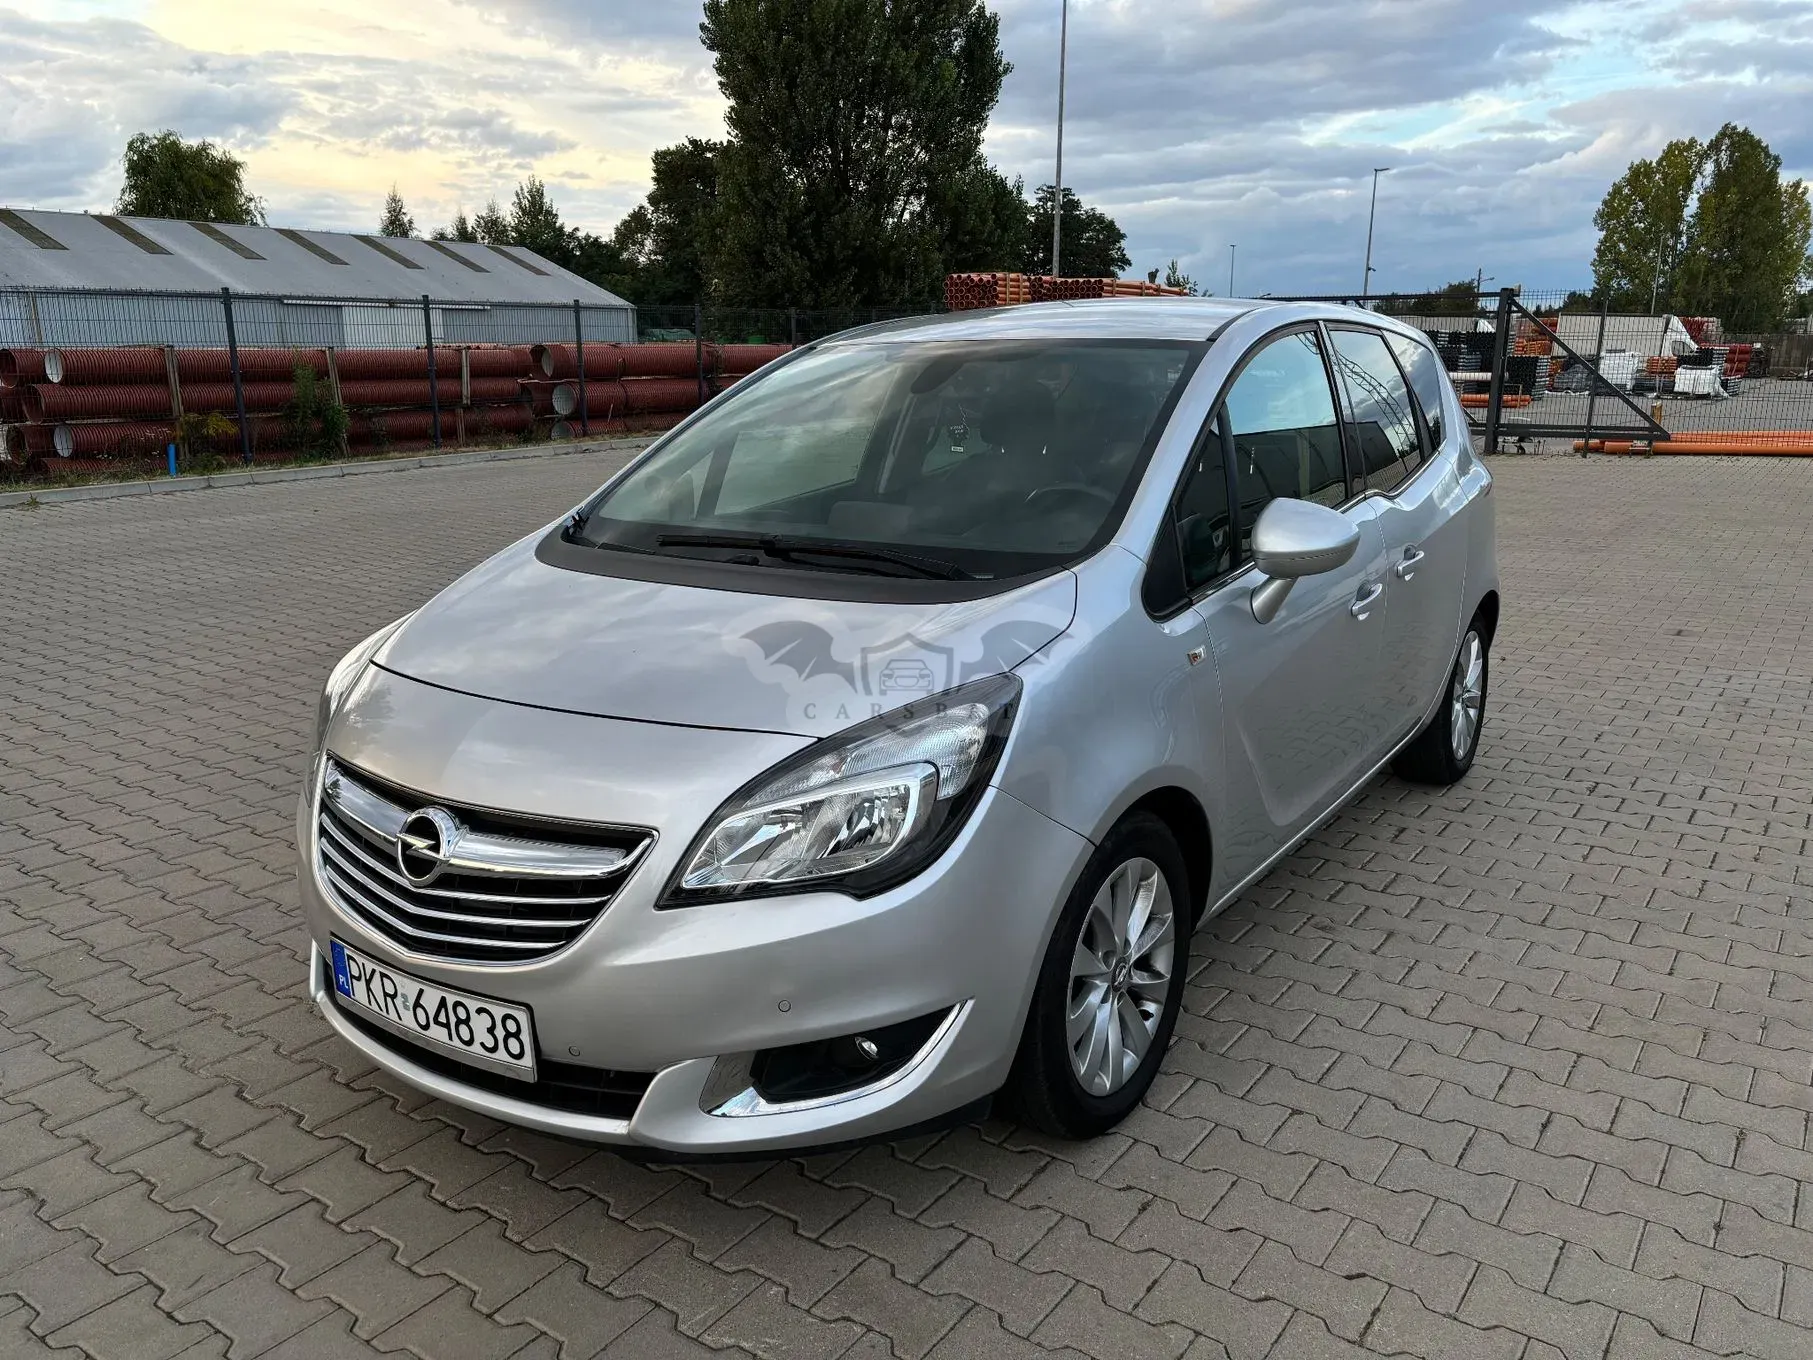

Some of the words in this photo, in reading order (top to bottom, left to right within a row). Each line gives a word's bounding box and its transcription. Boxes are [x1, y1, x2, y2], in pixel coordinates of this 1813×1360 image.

[338, 973, 349, 989] PL
[346, 952, 403, 1022] PKR
[412, 987, 526, 1061] 64838
